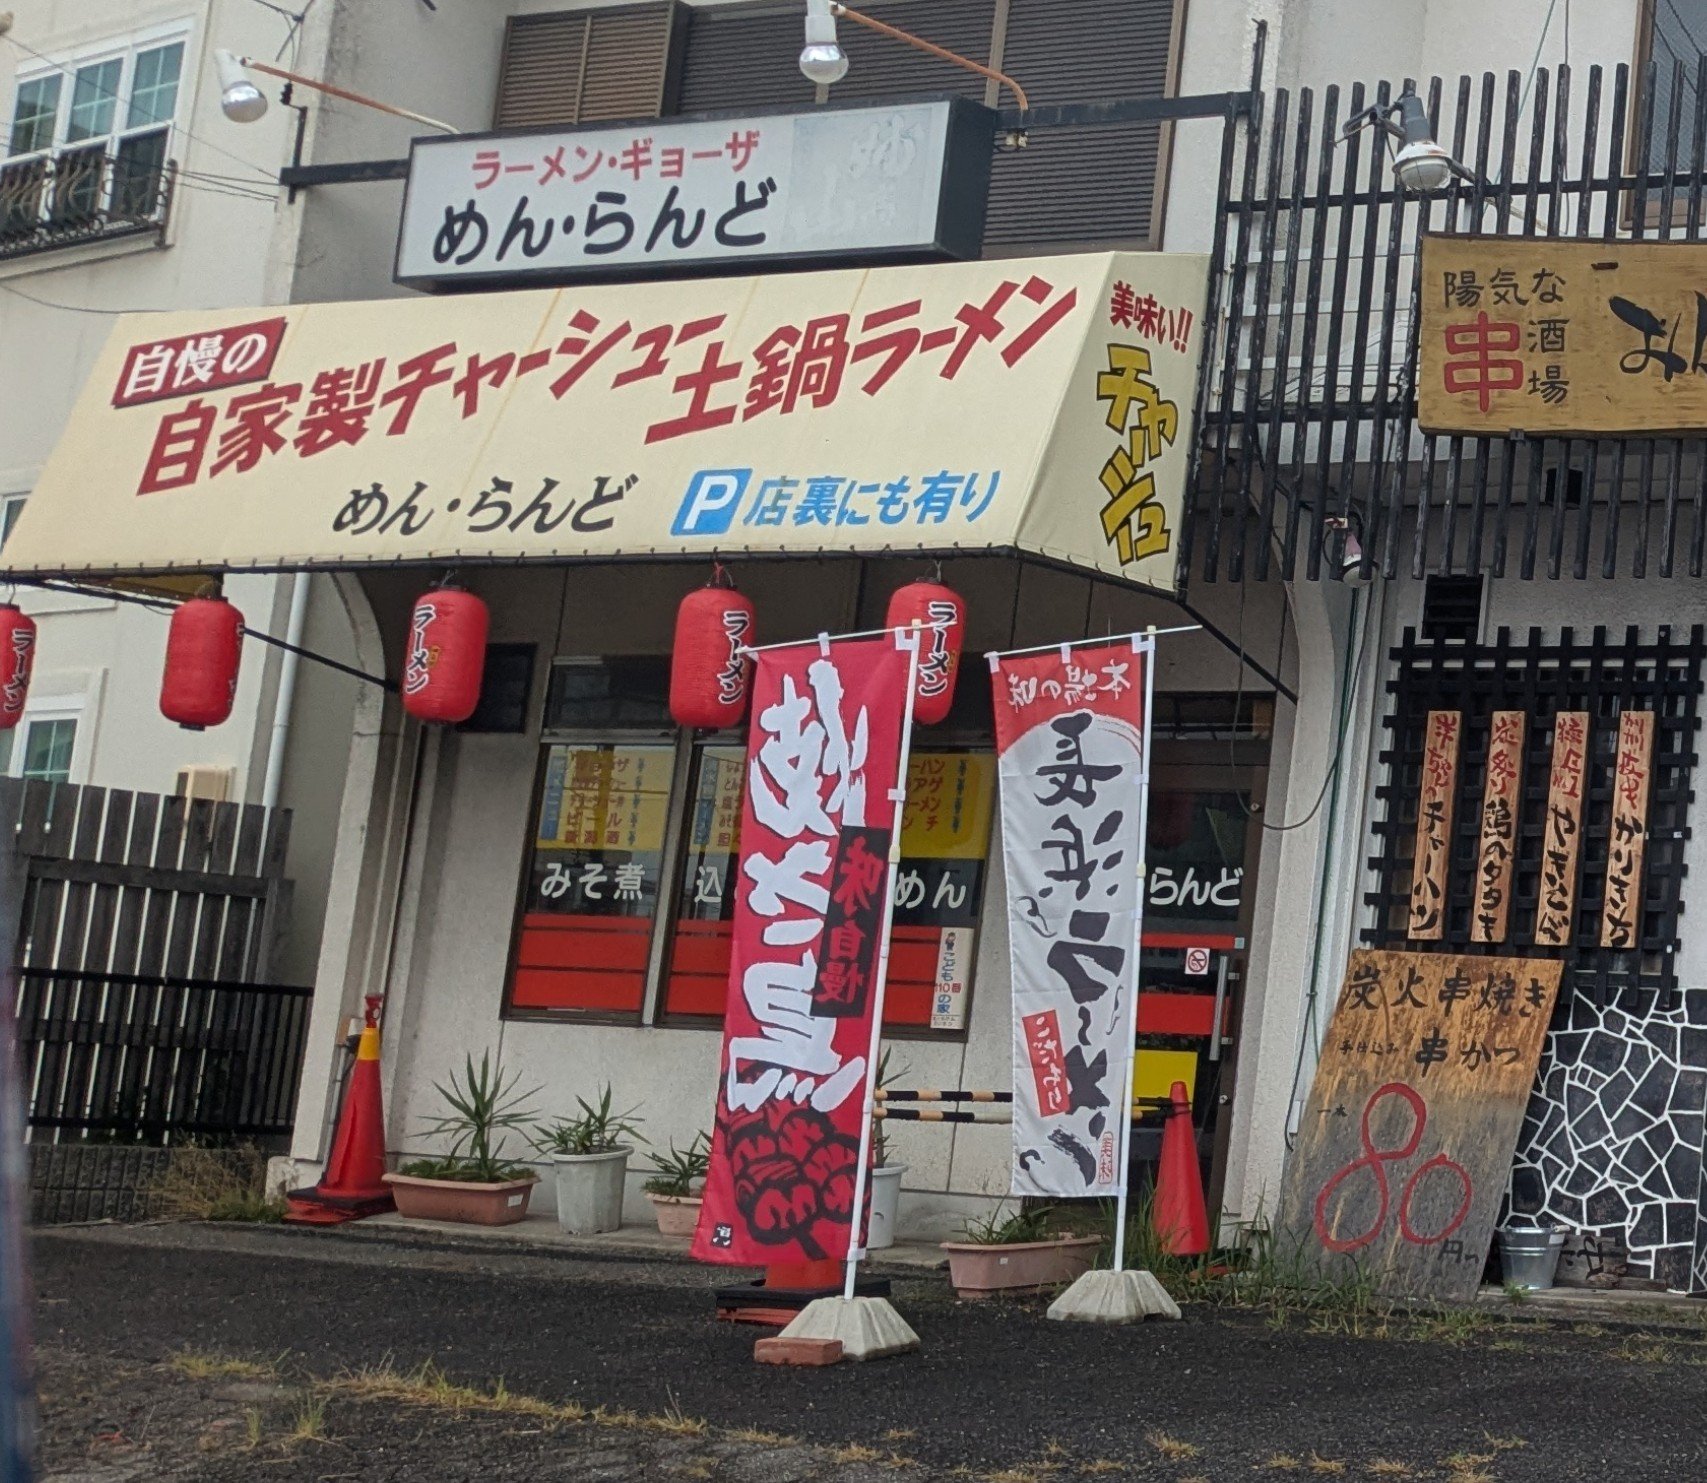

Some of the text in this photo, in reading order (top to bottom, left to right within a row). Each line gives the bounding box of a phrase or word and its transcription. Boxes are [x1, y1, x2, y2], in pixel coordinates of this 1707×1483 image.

[471, 129, 760, 190] ラーメン・ギョーザ
[433, 176, 777, 265] めん・らんど
[1443, 268, 1566, 307] 陽気な
[122, 330, 269, 399] 自慢の
[1444, 311, 1524, 413] 串
[1528, 318, 1570, 404] 酒場
[332, 472, 639, 536] めん・らんど
[742, 469, 1001, 528] 店裏にも有り
[406, 604, 437, 694] ラーメン
[717, 610, 750, 704] ラーメン
[918, 601, 957, 696] ラーメン
[540, 861, 646, 901] みそ煮
[1150, 867, 1244, 906] らんど
[1345, 965, 1549, 1018] 炭火串焼き
[1415, 1026, 1521, 1078] 串かつ
